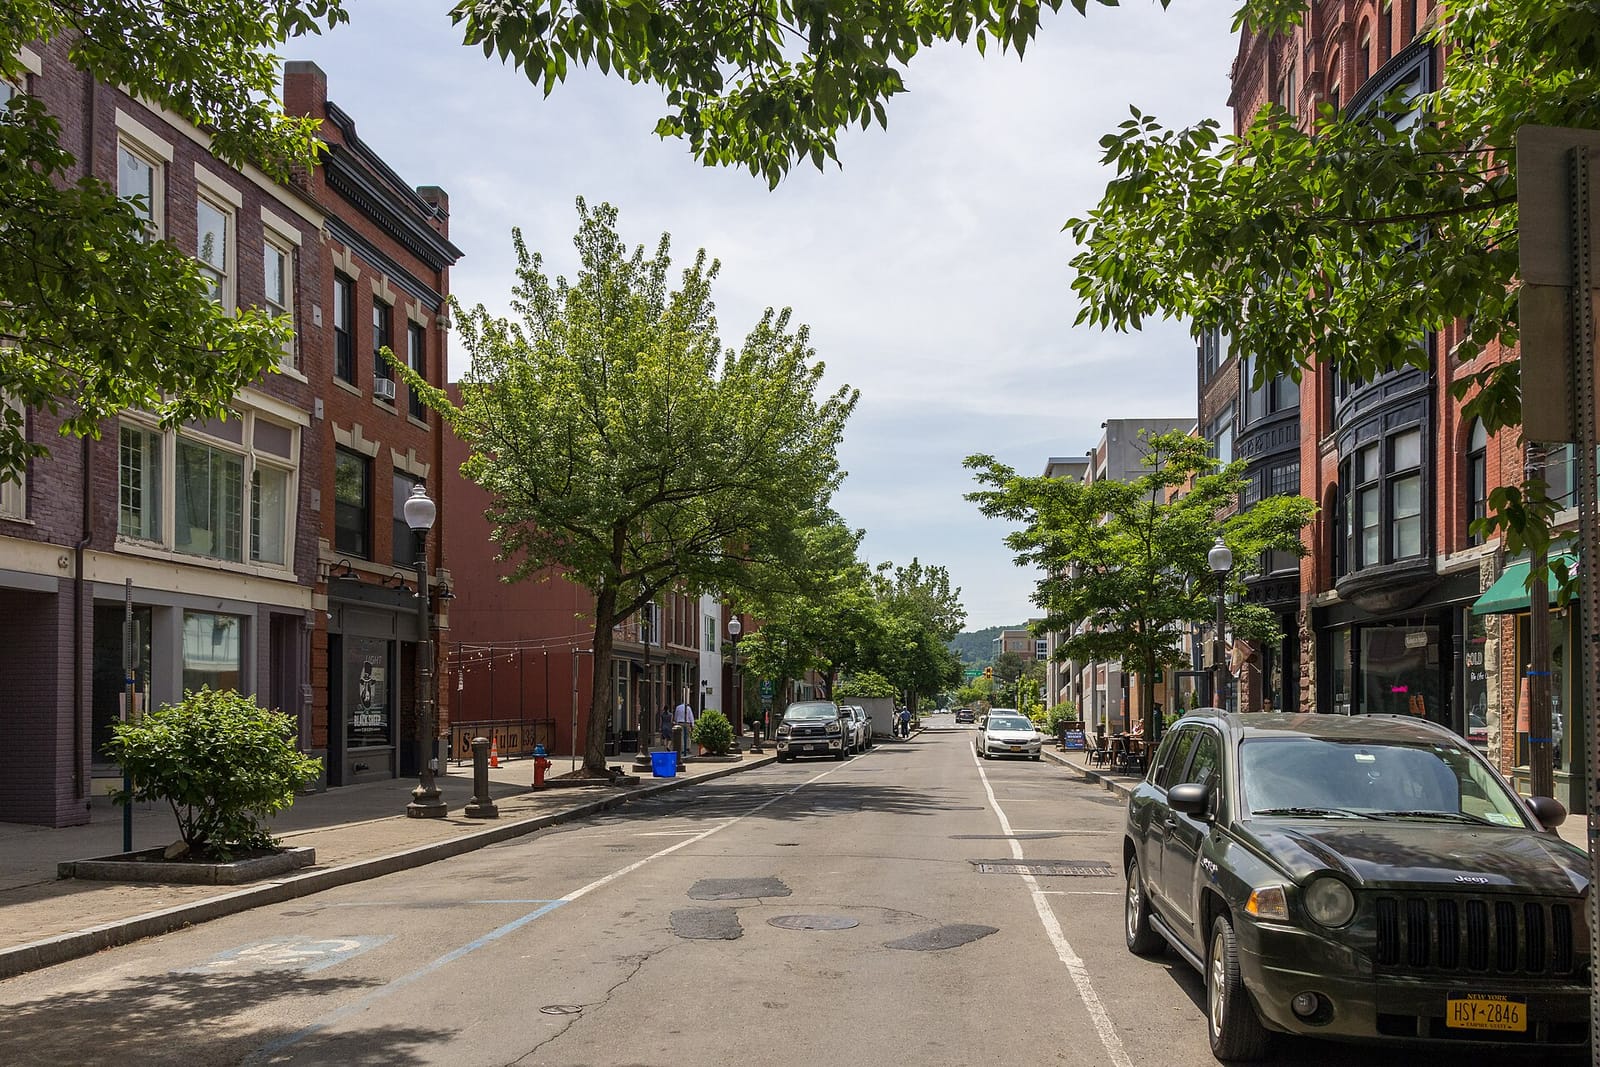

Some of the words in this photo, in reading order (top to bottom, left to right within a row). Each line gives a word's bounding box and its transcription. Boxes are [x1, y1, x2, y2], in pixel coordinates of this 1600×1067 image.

[1454, 875, 1489, 884] Jeep
[1487, 993, 1508, 1001] YORK
[1454, 1002, 1477, 1021] HSY
[1487, 1003, 1519, 1023] 2846
